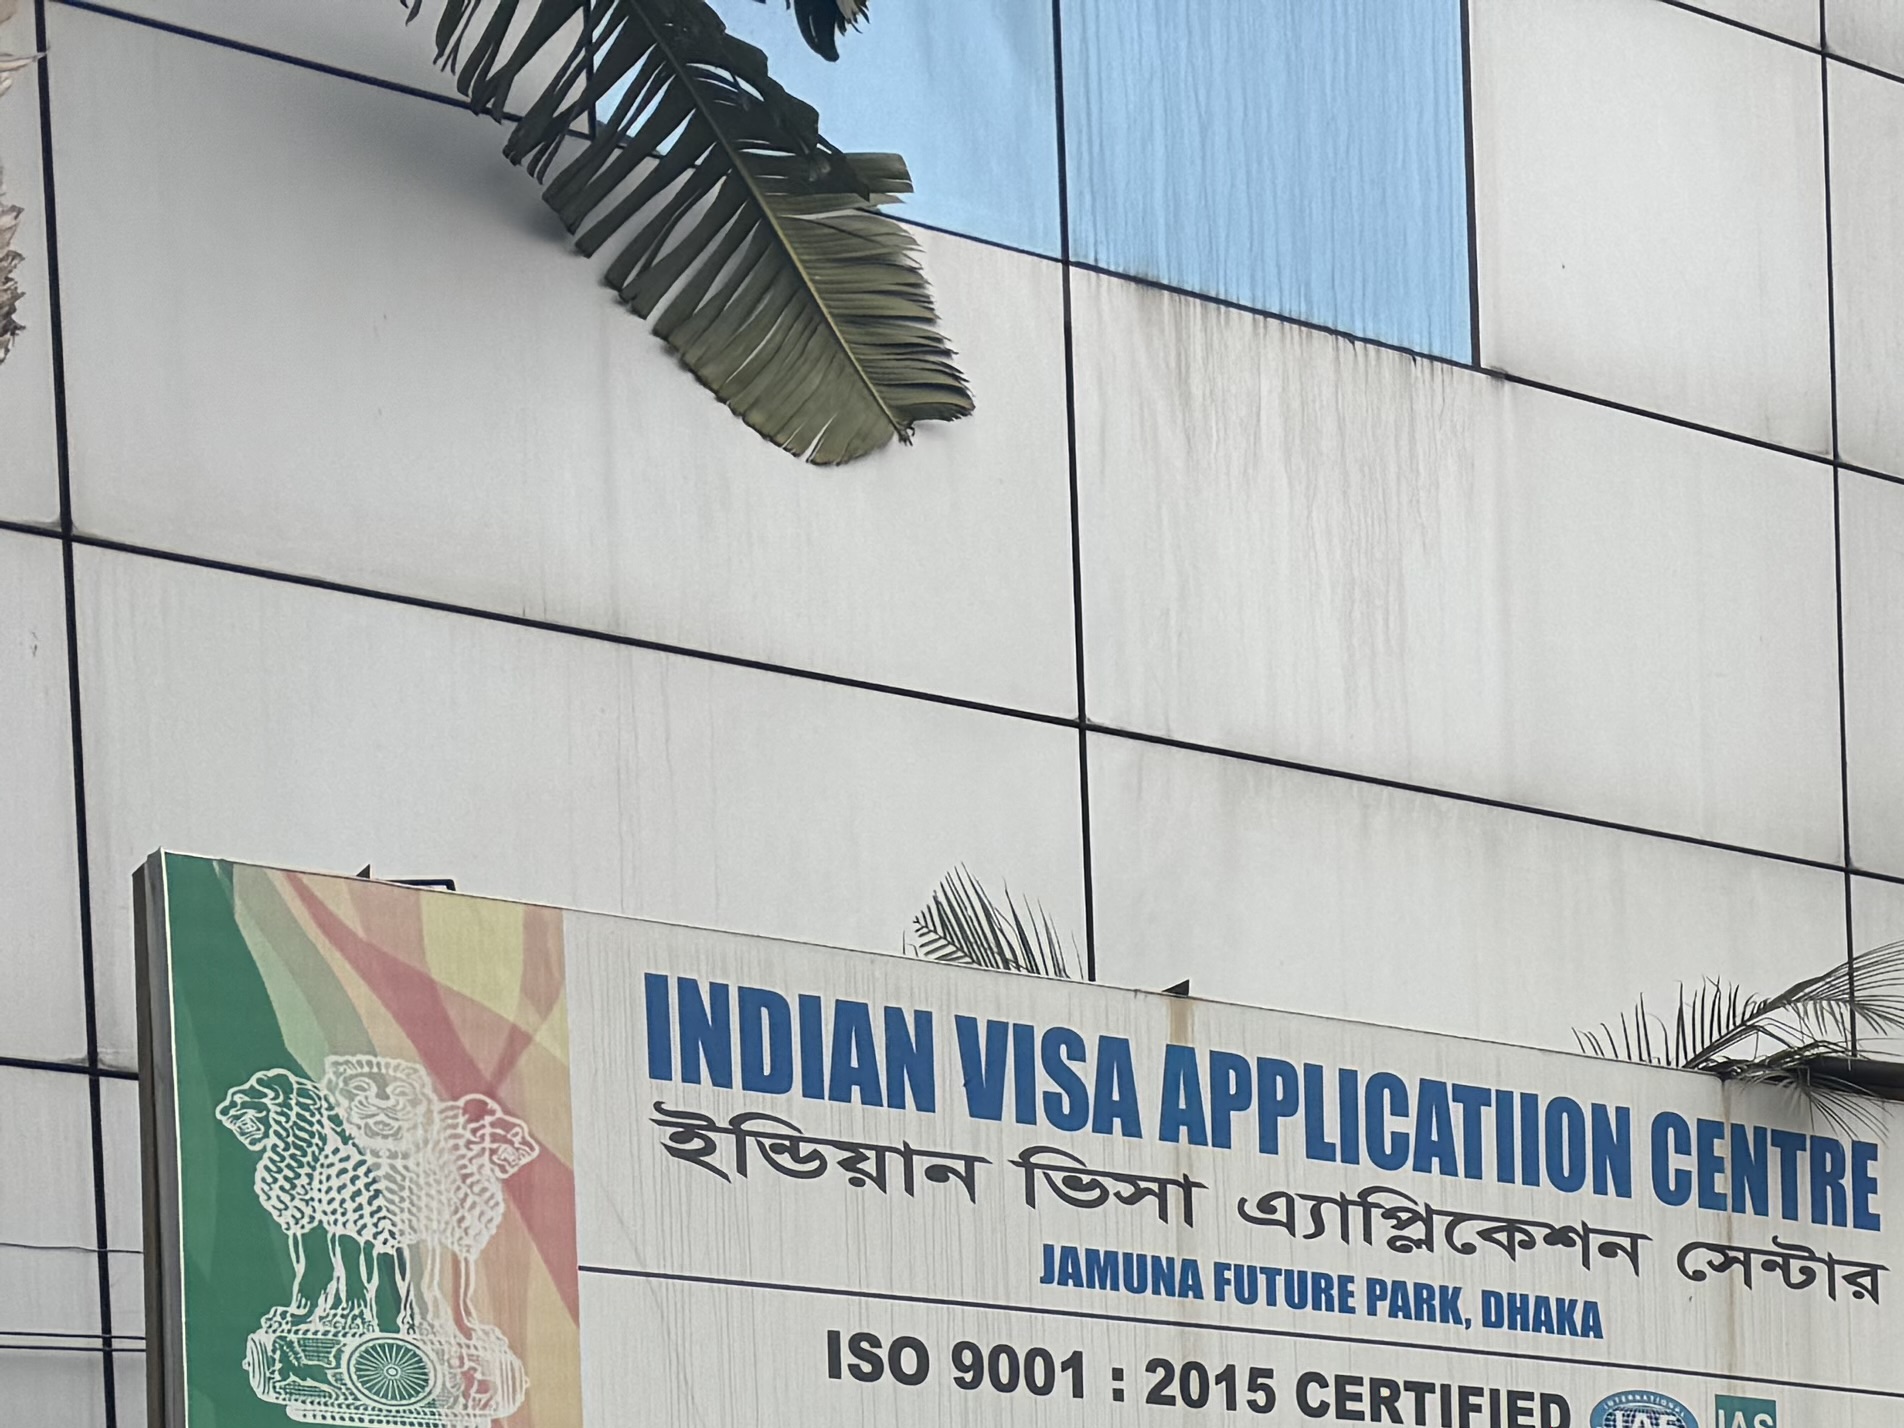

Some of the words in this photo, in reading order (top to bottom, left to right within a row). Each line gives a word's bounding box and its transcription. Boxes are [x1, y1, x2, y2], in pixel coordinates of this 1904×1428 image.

[644, 972, 935, 1113] INDIAN
[955, 1015, 1143, 1139] VISA
[1160, 1043, 1633, 1198] APPLICATIION
[1651, 1111, 1881, 1231] CENTRE
[649, 1101, 992, 1204] ইন্ডিয়ান
[1008, 1145, 1210, 1228] ভিসা
[1677, 1235, 1890, 1304] সেন্টার
[1040, 1243, 1204, 1301] JAMUNA
[1214, 1261, 1355, 1315] FUTURE
[1366, 1278, 1472, 1330] PARK,
[1482, 1290, 1604, 1340] DHAKA
[827, 1329, 930, 1386] ISO
[951, 1341, 1085, 1398] 9001
[1145, 1357, 1276, 1414] 2015
